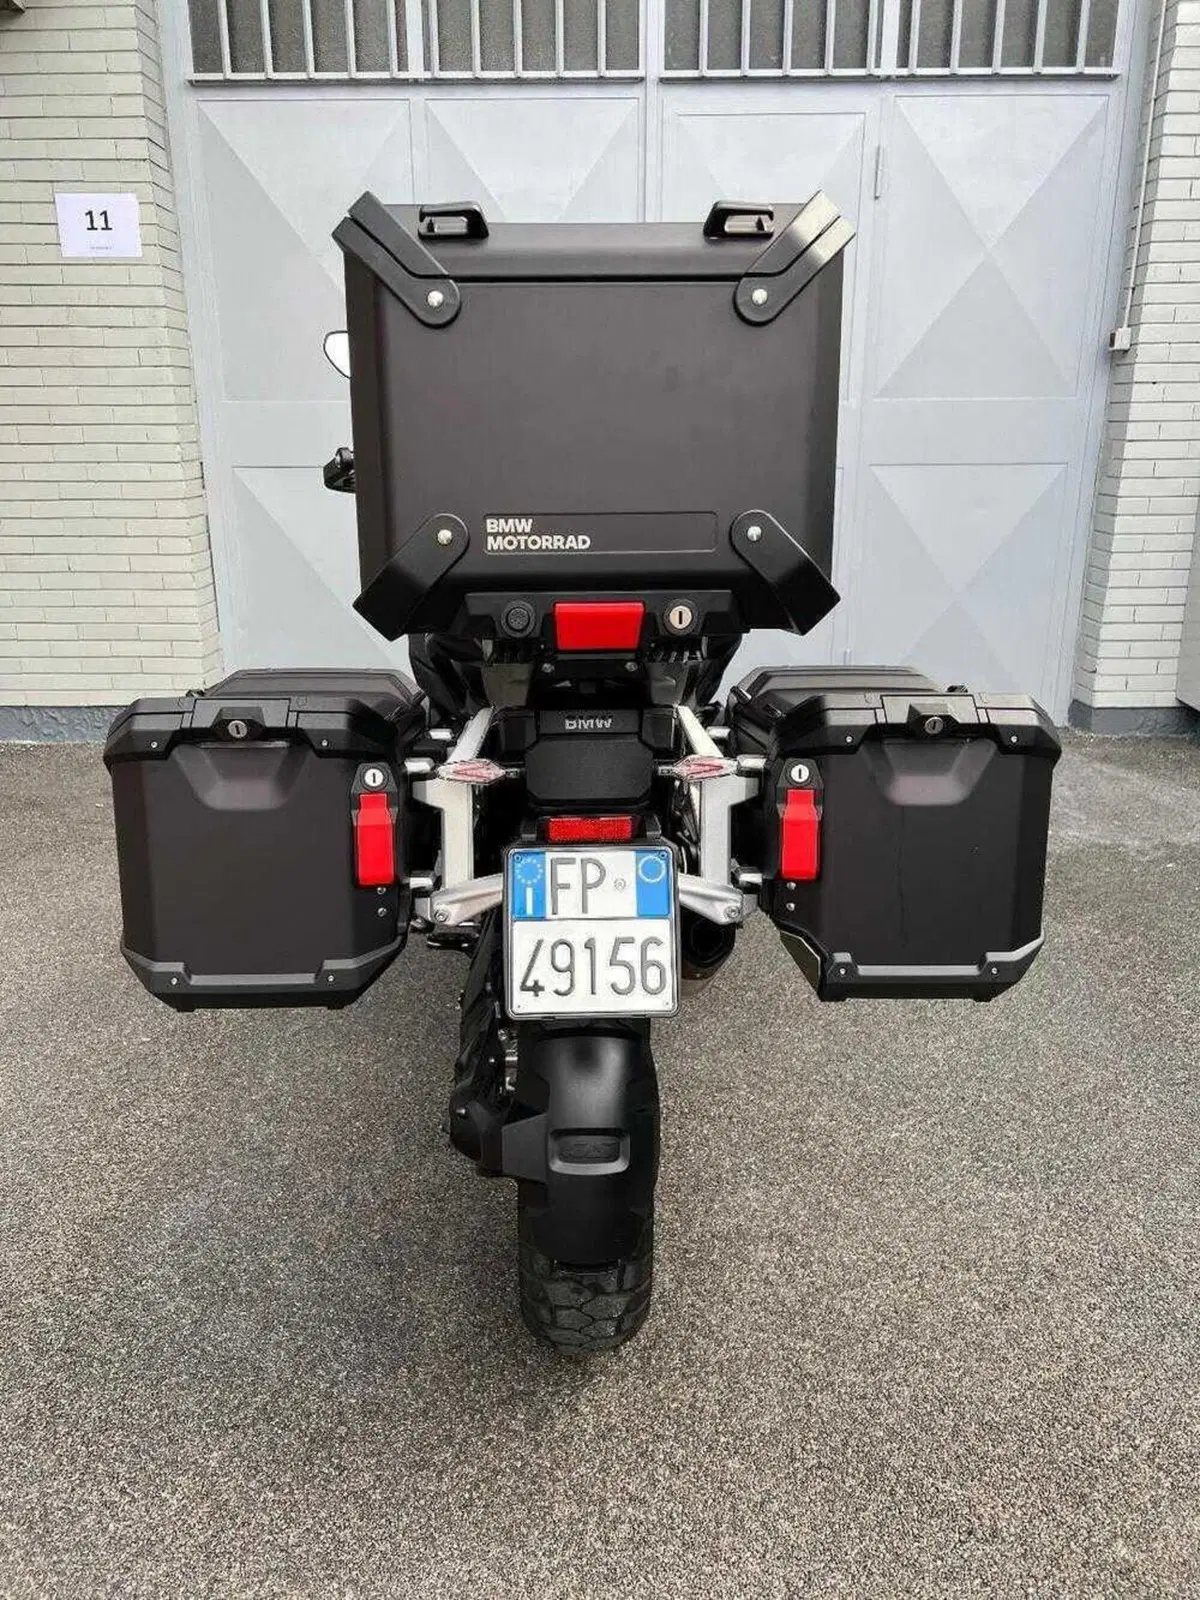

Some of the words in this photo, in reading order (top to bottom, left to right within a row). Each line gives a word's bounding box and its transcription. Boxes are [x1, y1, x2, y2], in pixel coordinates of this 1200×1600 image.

[85, 210, 113, 231] 11
[486, 518, 533, 533] BMW
[487, 535, 592, 550] MOTORRAD
[551, 857, 607, 915] FP
[519, 936, 667, 997] 49156
